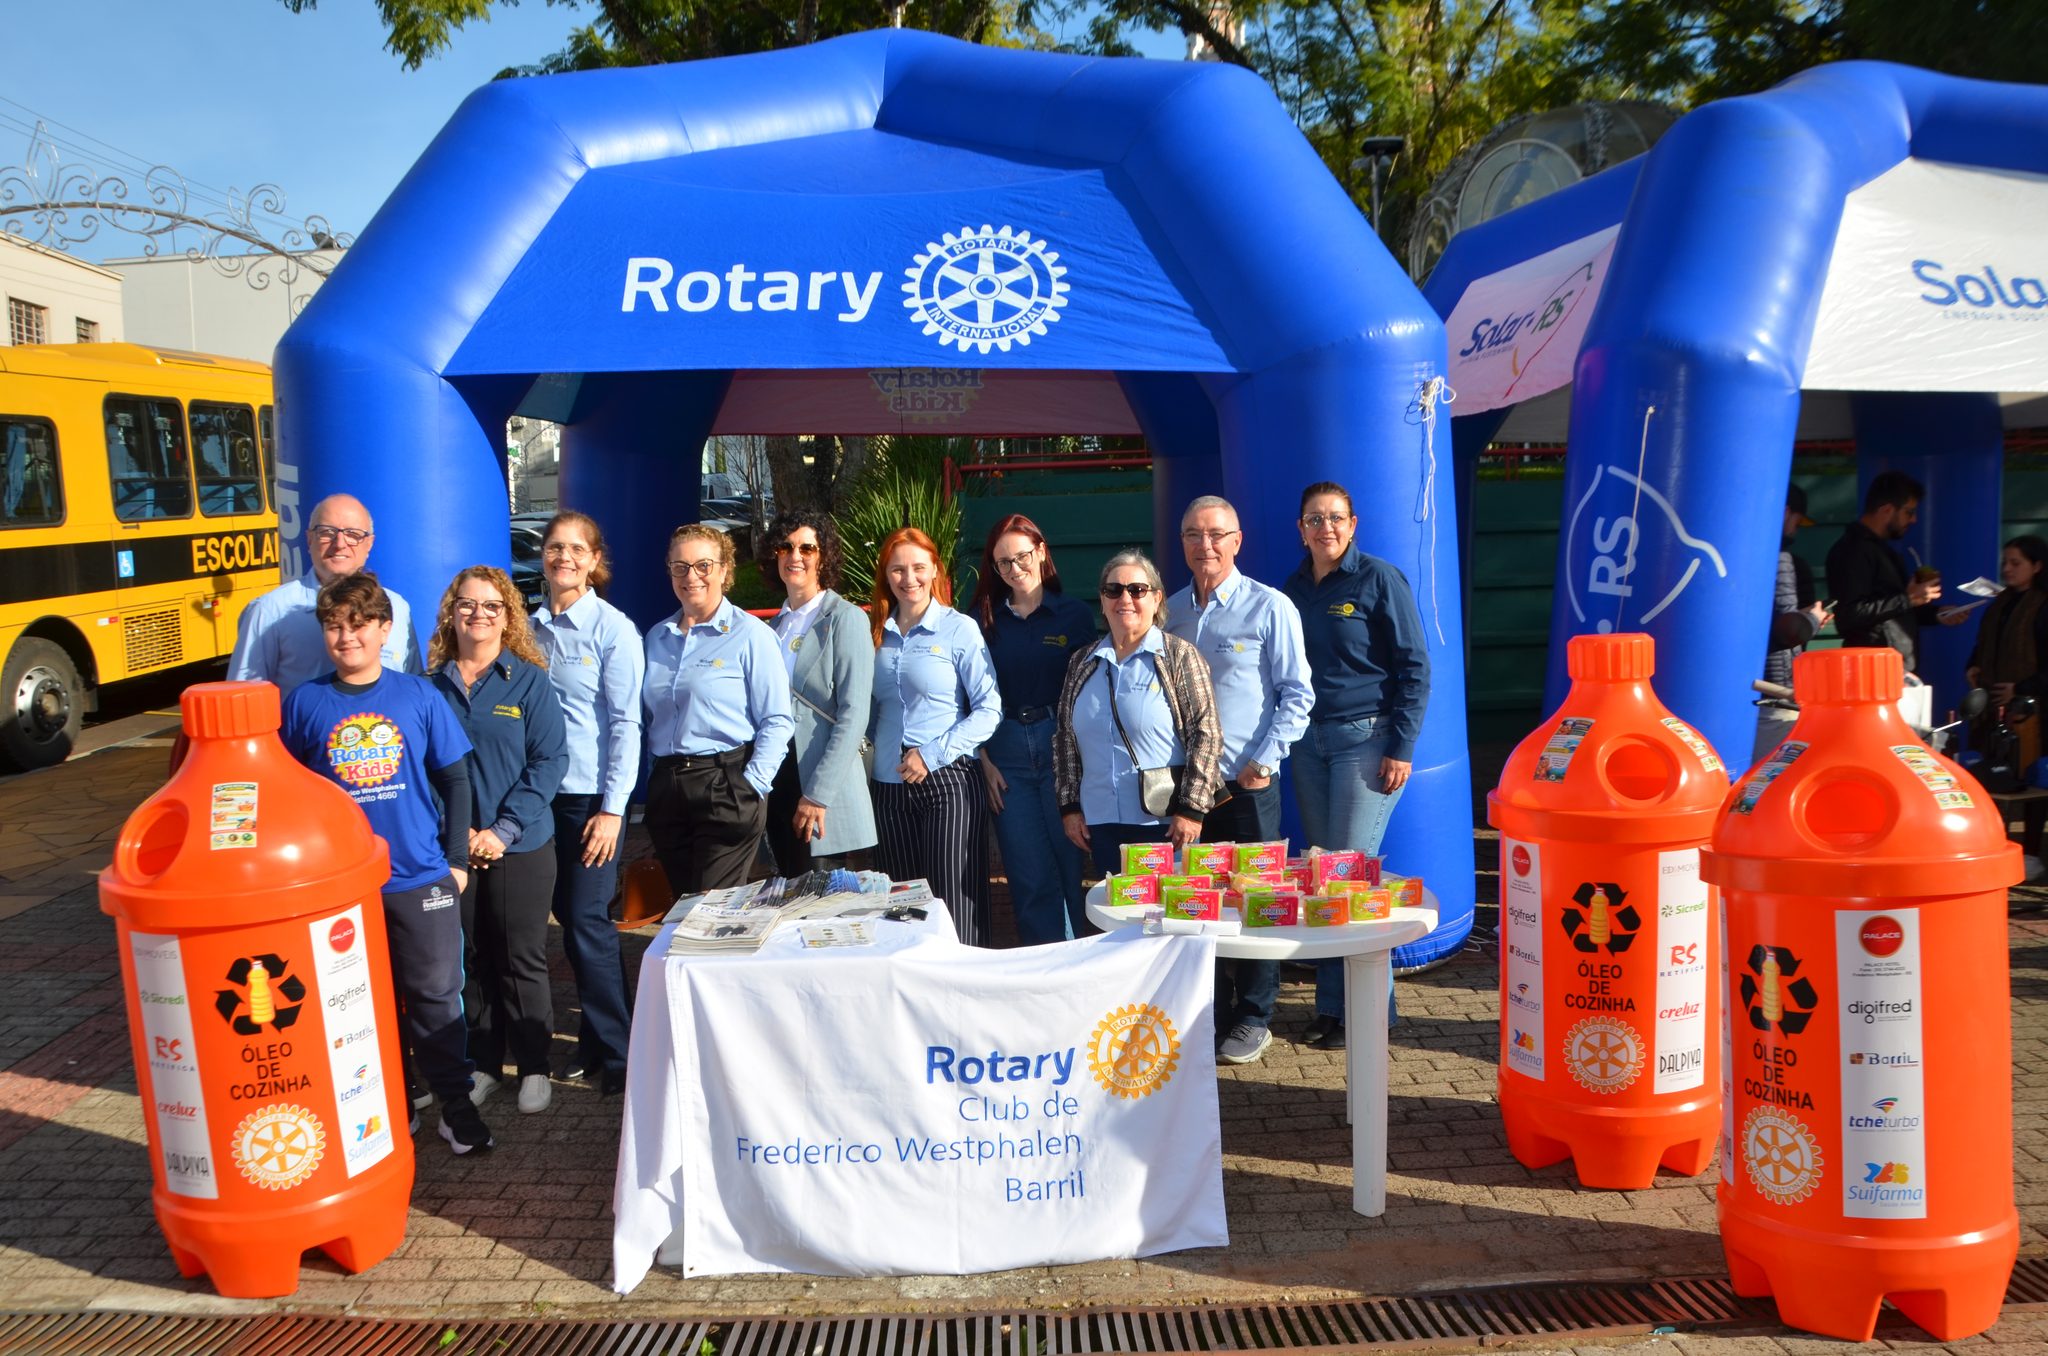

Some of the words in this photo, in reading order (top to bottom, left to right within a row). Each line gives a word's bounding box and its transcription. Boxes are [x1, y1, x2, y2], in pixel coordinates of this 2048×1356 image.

[952, 238, 1020, 255] ROTARY
[621, 257, 883, 323] Rotary
[928, 303, 1047, 339] INTERNATIONAL
[192, 531, 279, 573] ESCOLA
[1588, 514, 1640, 597] RS
[330, 745, 401, 765] Rotary
[345, 763, 394, 781] Kids
[377, 791, 398, 800] 4660
[1670, 942, 1697, 966] RS
[1578, 960, 1622, 979] ÓLEO
[328, 980, 367, 1012] digifred
[1589, 980, 1610, 995] DE
[1564, 993, 1636, 1012] COZINHA
[1659, 1002, 1699, 1019] creluz
[1847, 999, 1912, 1024] digifred
[1112, 1015, 1154, 1030] ROTARY
[155, 1036, 183, 1061] RS
[241, 1042, 293, 1063] ÓLEO
[1753, 1039, 1797, 1067] ÓLEO
[257, 1062, 282, 1079] DE
[926, 1046, 1075, 1086] Rotary
[1102, 1059, 1168, 1088] INTERNATIONAL
[1659, 1049, 1701, 1074] DALPIVA
[230, 1074, 313, 1100] COZINHA
[1763, 1065, 1785, 1085] DE
[958, 1095, 1029, 1123] Club
[1043, 1090, 1080, 1118] de
[1744, 1078, 1815, 1111] COZINHA
[158, 1101, 197, 1117] creluz
[735, 1136, 882, 1165] Frederico
[895, 1130, 1083, 1168] Westphalen
[1005, 1173, 1086, 1203] Barril
[1848, 1184, 1923, 1205] Suifarma
